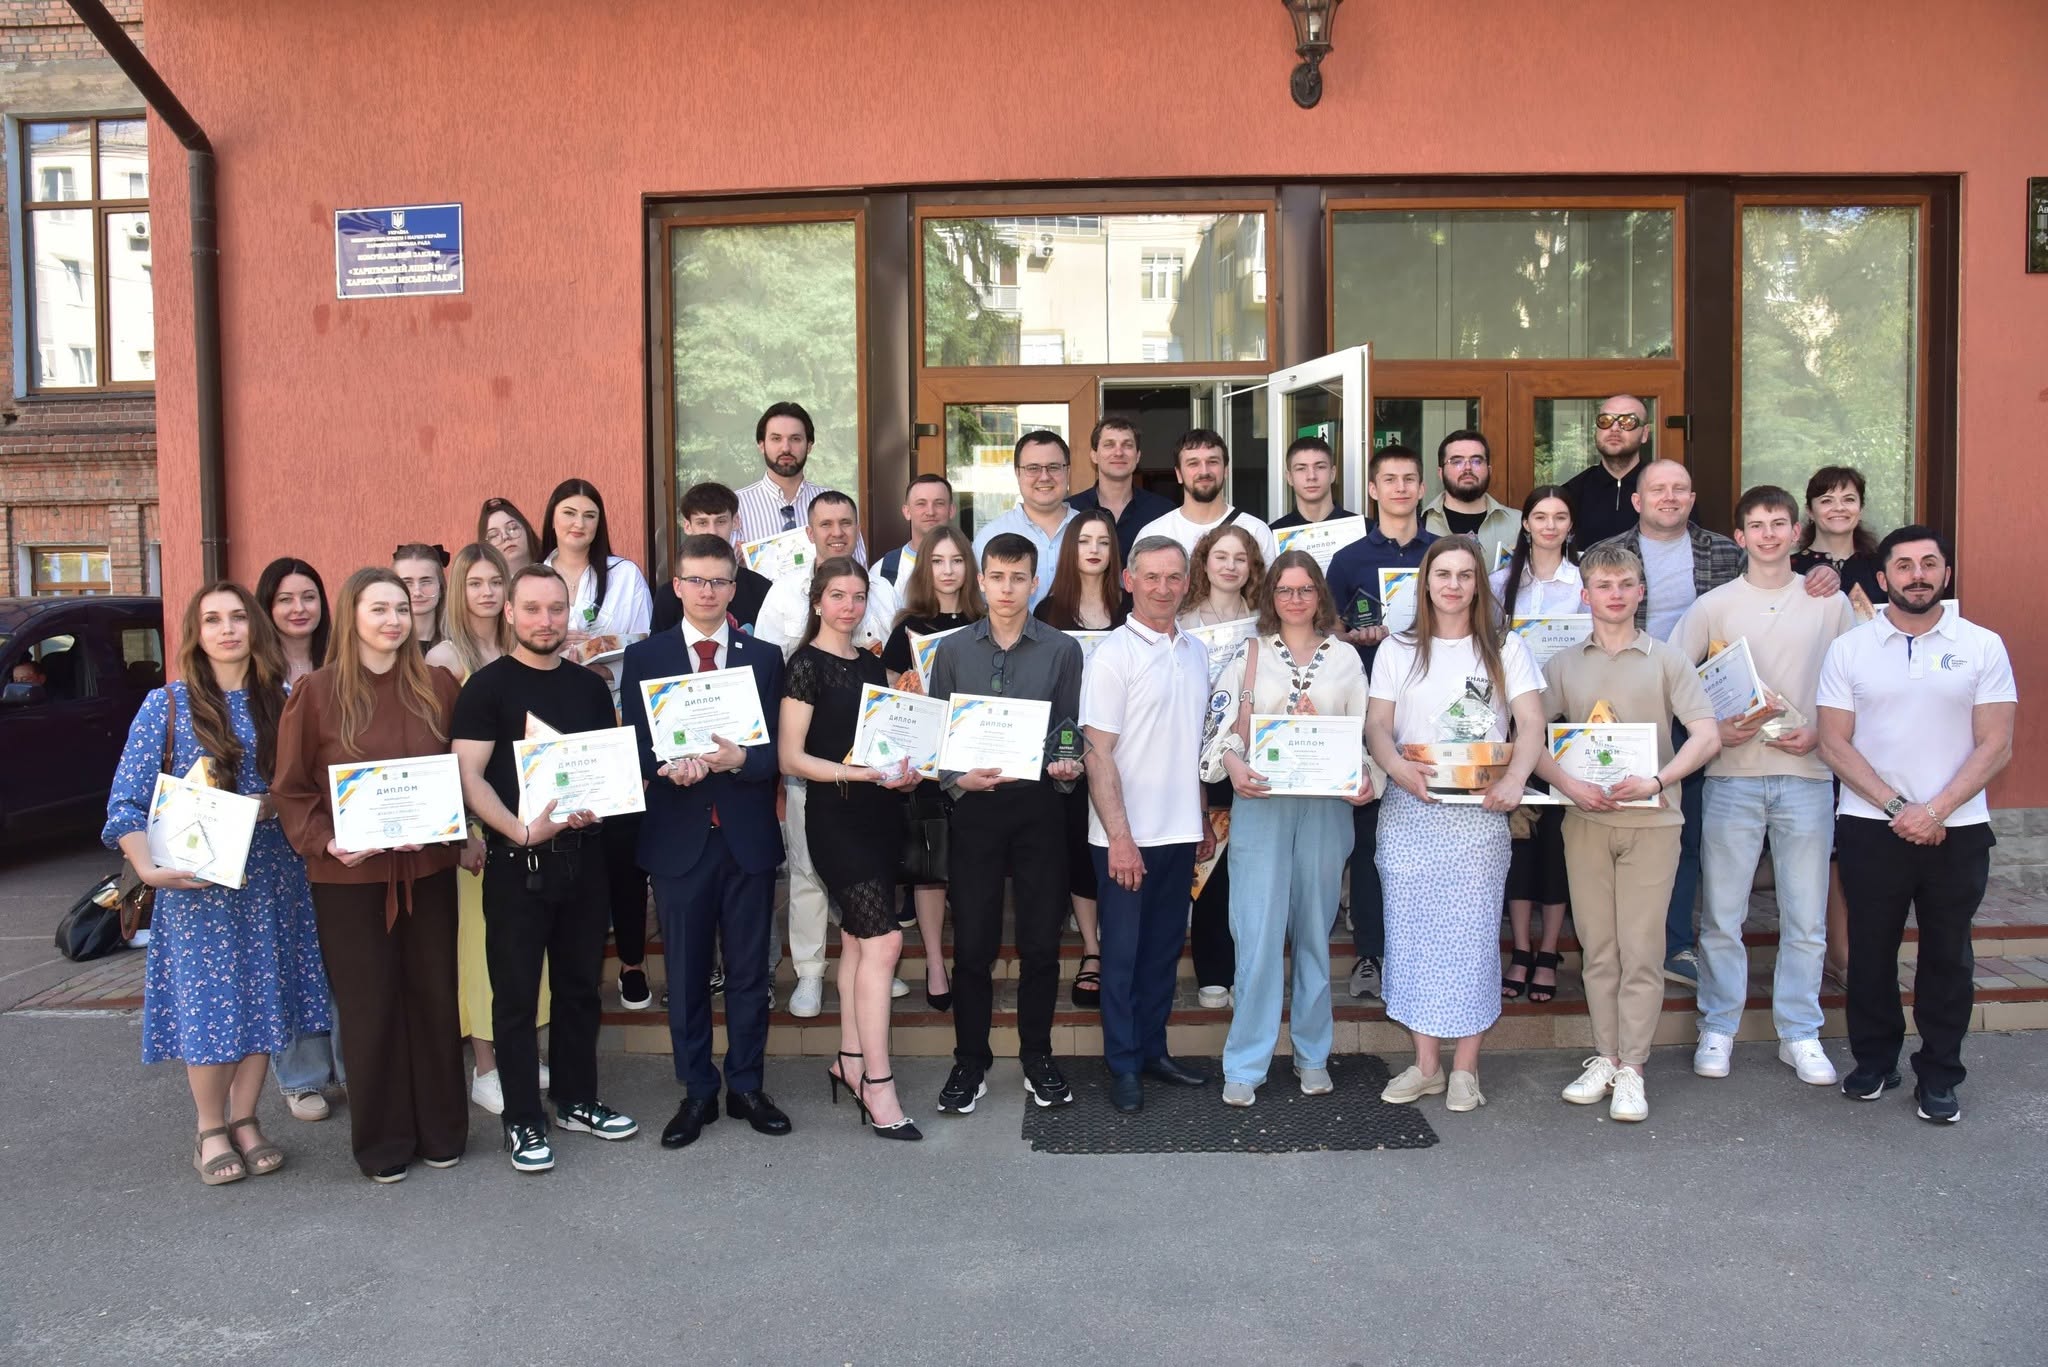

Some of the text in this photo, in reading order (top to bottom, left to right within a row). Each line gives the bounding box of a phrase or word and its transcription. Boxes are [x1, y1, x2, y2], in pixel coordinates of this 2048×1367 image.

[1306, 541, 1337, 550] ДИПЛОМ
[684, 695, 721, 707] ДИПЛОМ
[888, 714, 917, 725] ДИПЛОМ
[979, 719, 1014, 729] ДИПЛОМ
[1288, 739, 1325, 747] ДИПЛОМ
[558, 758, 598, 769] ДИПЛОМ
[376, 784, 418, 796] ДИПЛОМ
